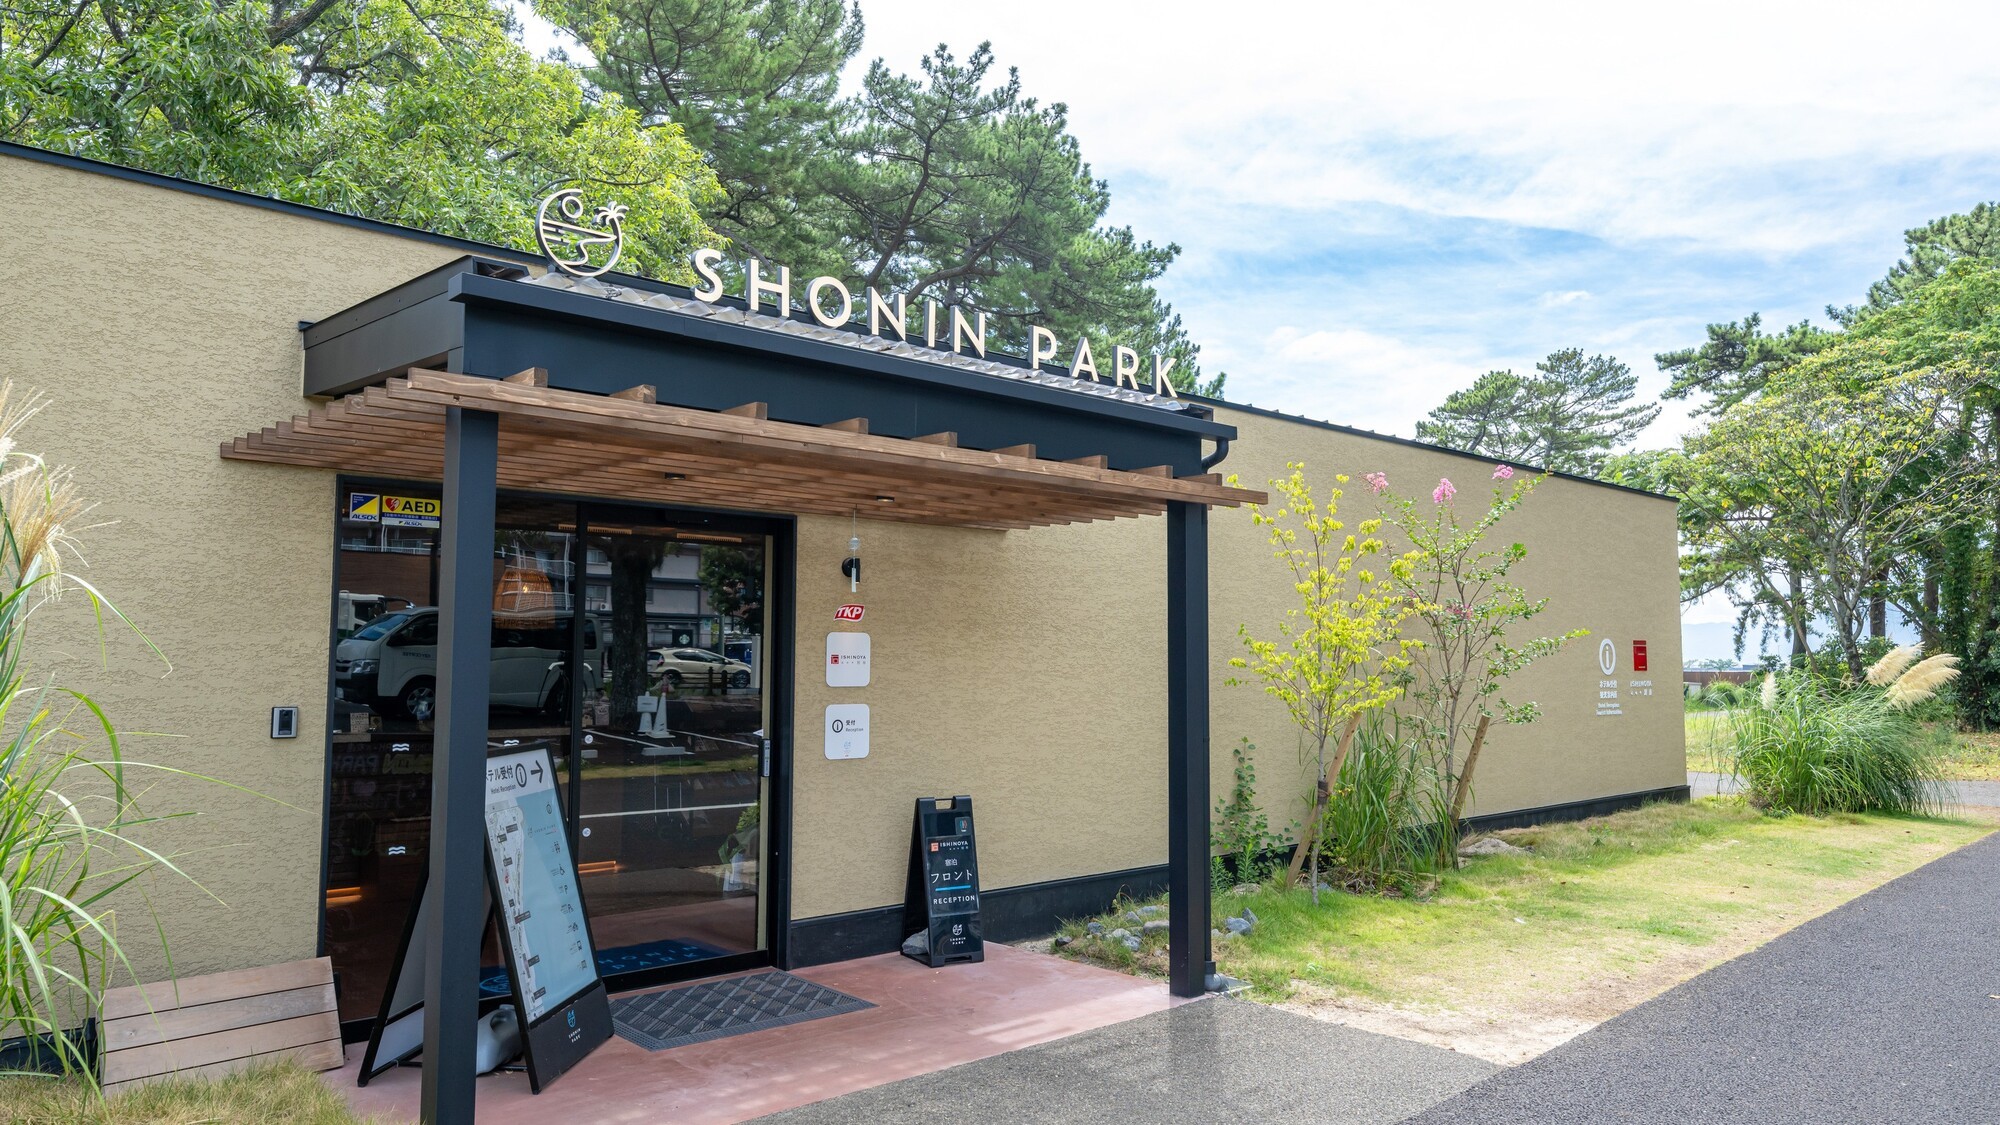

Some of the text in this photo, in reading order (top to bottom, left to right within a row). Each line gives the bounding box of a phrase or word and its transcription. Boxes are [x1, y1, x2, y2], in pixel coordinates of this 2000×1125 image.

[690, 248, 1178, 398] SHONIN PARK
[401, 500, 435, 513] AED
[351, 513, 377, 521] ALSOK
[837, 607, 862, 618] TKP
[491, 784, 516, 794] Hotel Reception
[931, 869, 972, 883] フロント
[933, 895, 975, 904] RECEPTION
